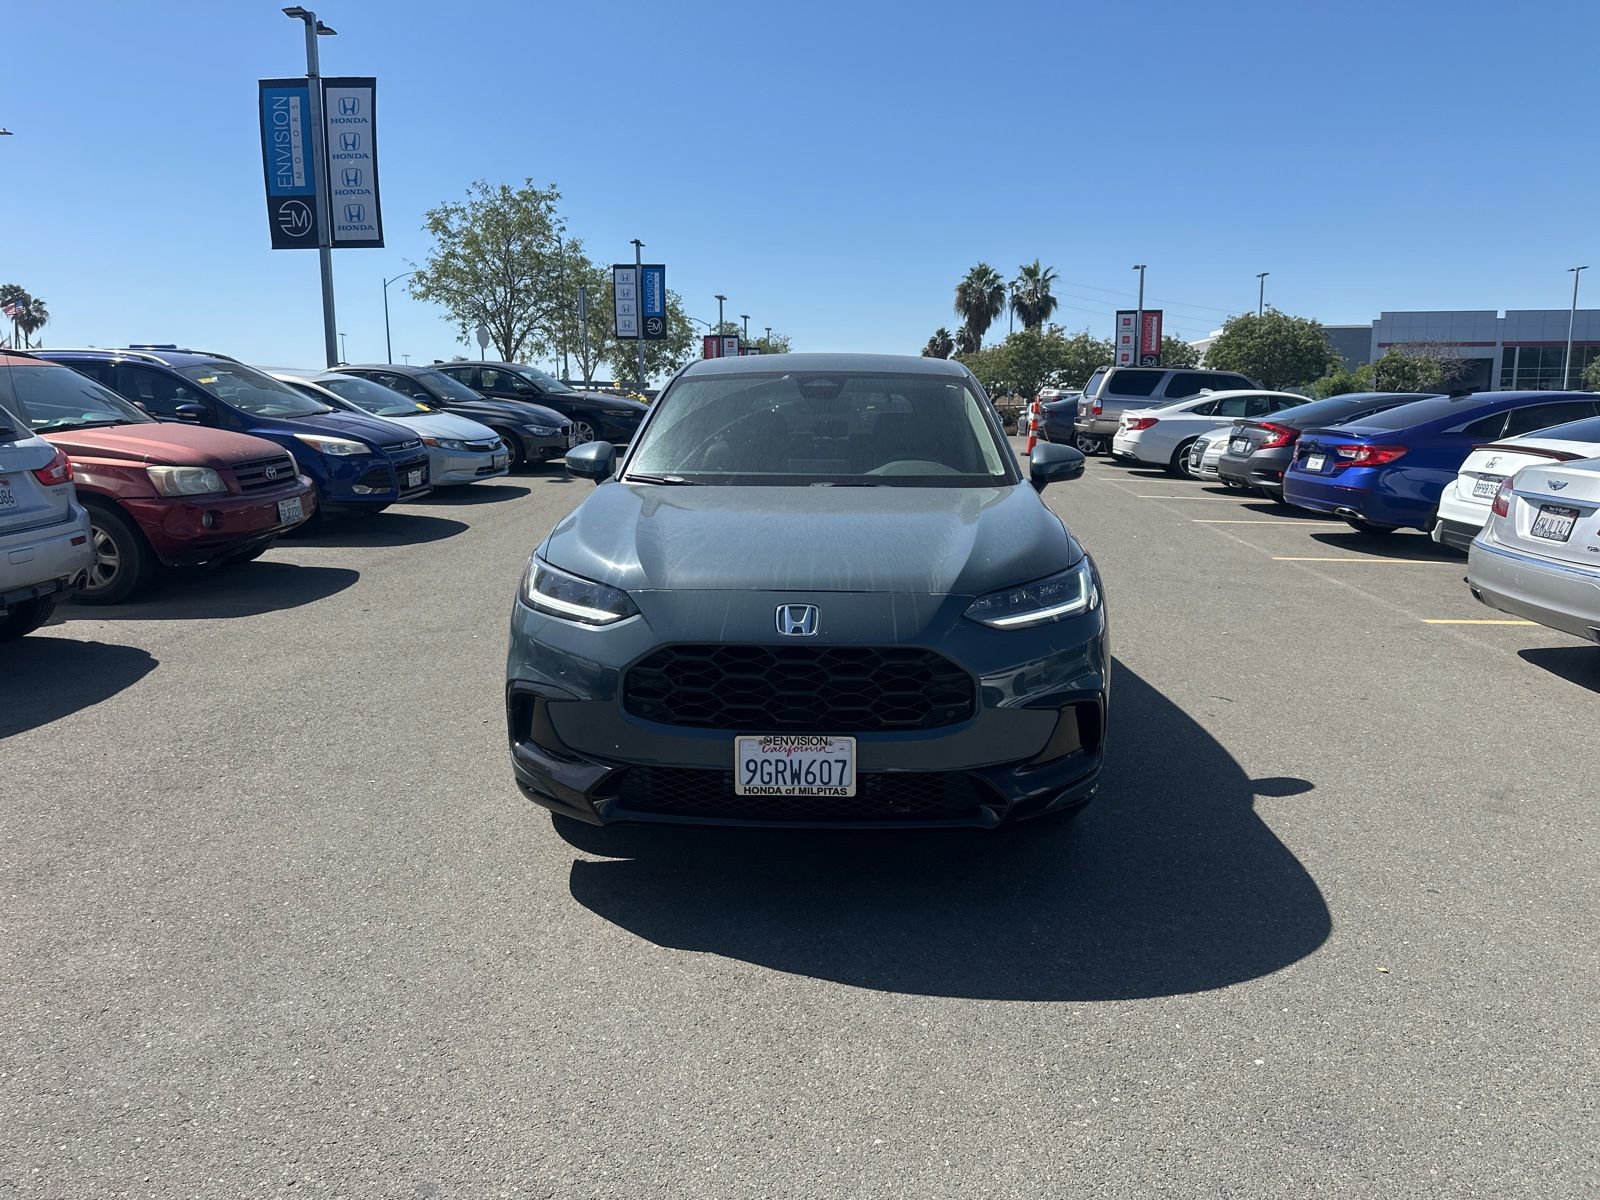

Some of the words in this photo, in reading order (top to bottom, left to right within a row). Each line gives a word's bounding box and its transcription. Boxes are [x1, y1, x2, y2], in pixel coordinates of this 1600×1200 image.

[273, 96, 292, 188] ENVISION
[292, 104, 303, 181] MOTORS
[1145, 315, 1153, 351] ENVISION
[773, 736, 828, 746] ENVISION
[745, 759, 848, 786] 9GRW607
[743, 786, 782, 795] HONDA
[785, 786, 796, 795] of
[798, 787, 848, 796] MILPITAS
